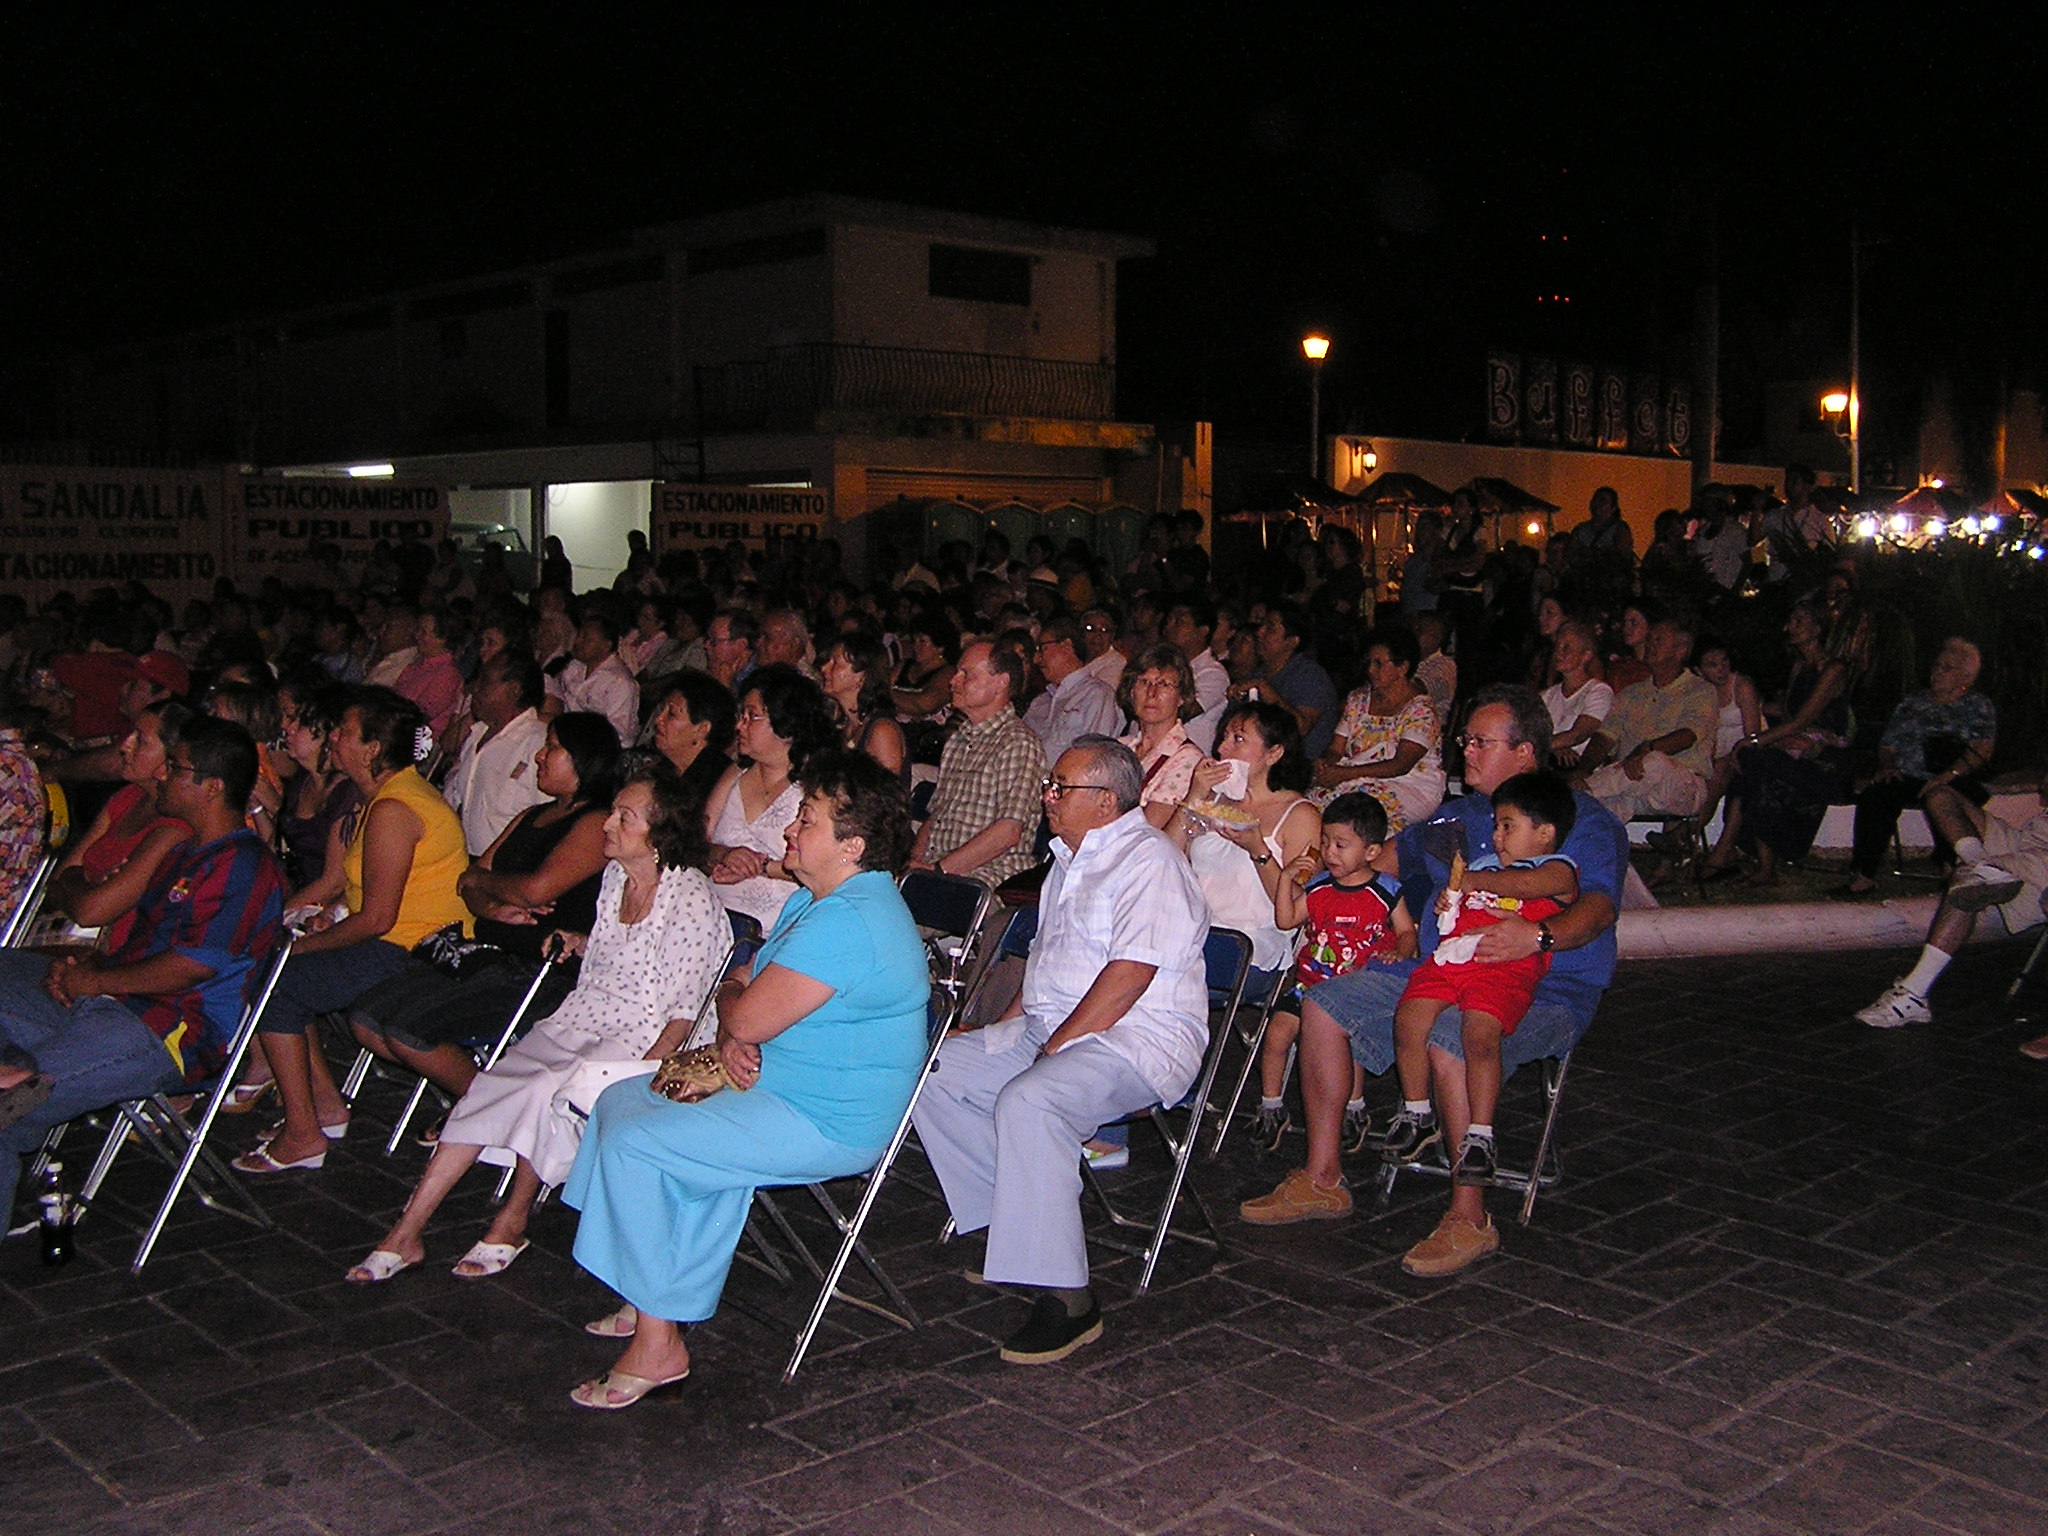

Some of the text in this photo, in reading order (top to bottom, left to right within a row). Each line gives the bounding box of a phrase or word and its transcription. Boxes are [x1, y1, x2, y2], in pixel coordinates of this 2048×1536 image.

[1487, 358, 1692, 448] Buffet
[20, 481, 209, 520] SANDALIA
[244, 485, 438, 510] ESTACIONAMIENTO
[662, 491, 825, 515] ESTACIONAMIENTO
